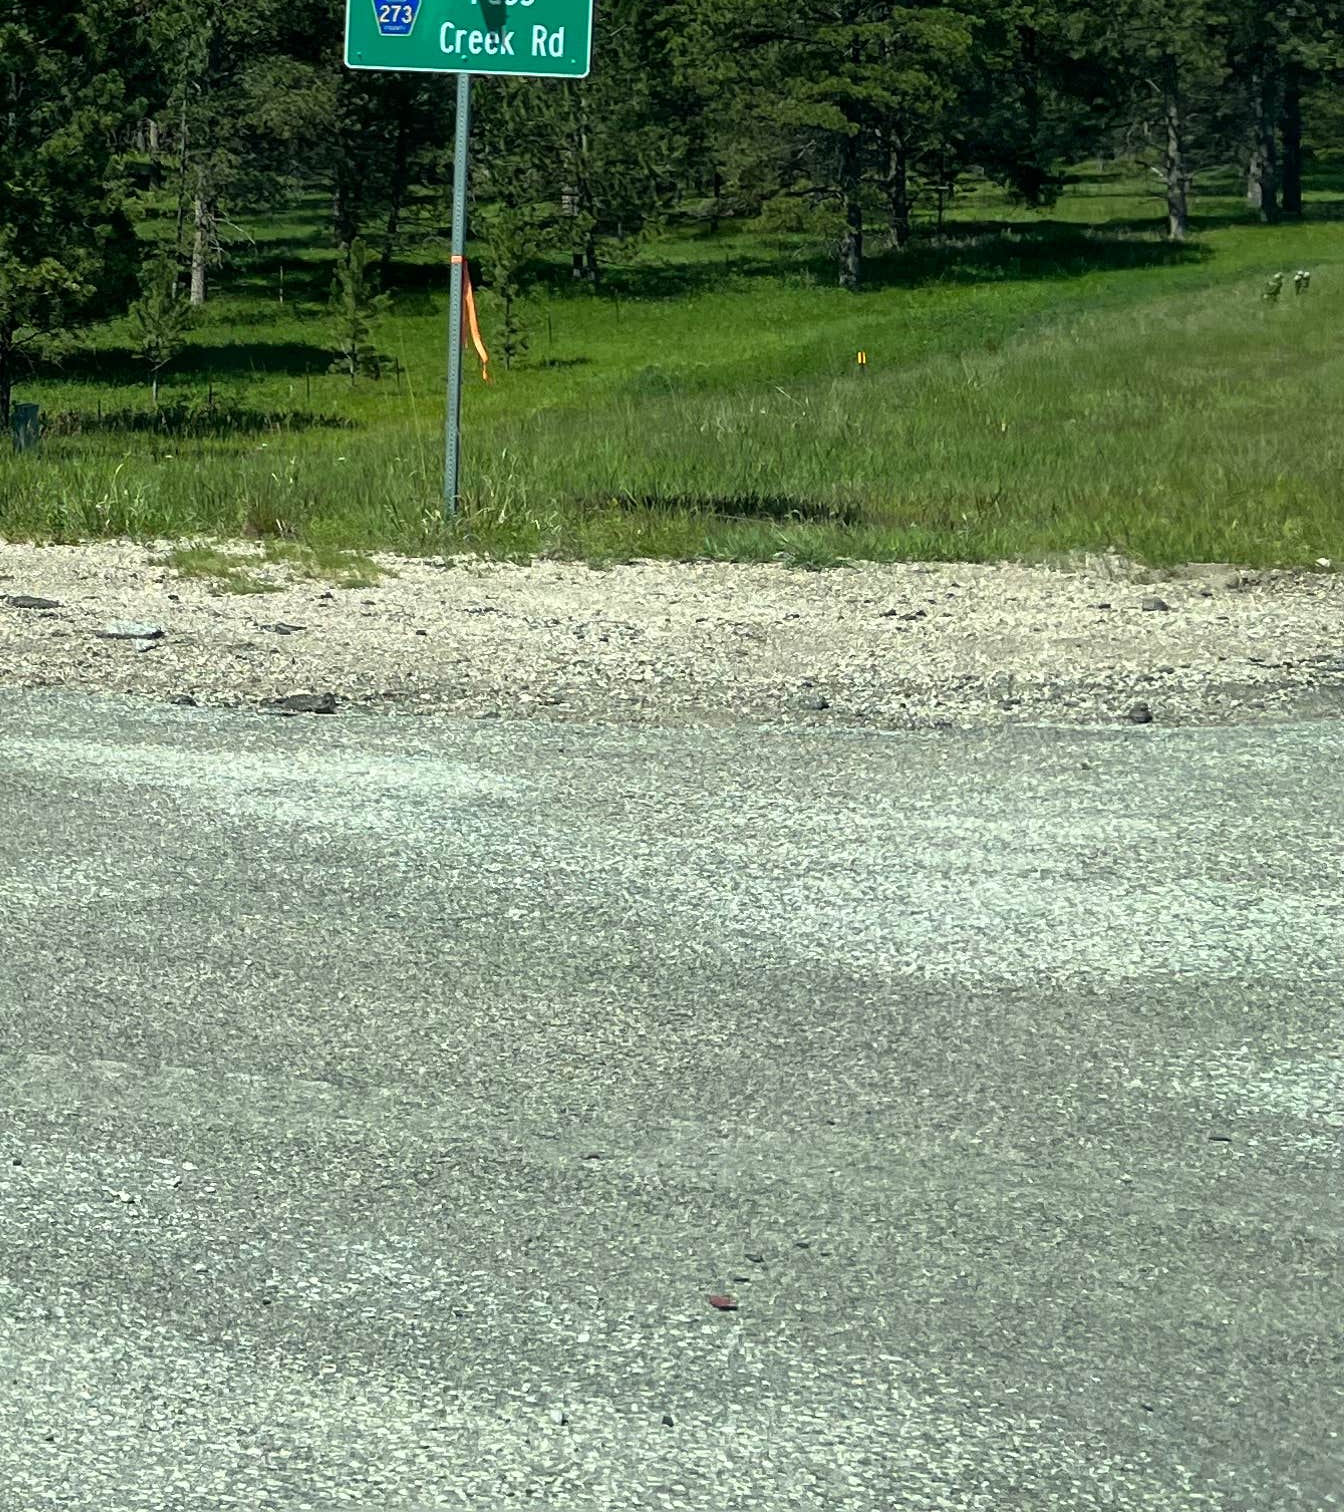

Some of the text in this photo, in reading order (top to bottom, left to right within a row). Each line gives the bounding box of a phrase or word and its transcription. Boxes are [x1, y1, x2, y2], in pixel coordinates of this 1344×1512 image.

[379, 4, 413, 24] 273
[439, 21, 565, 57] Creek Rd
